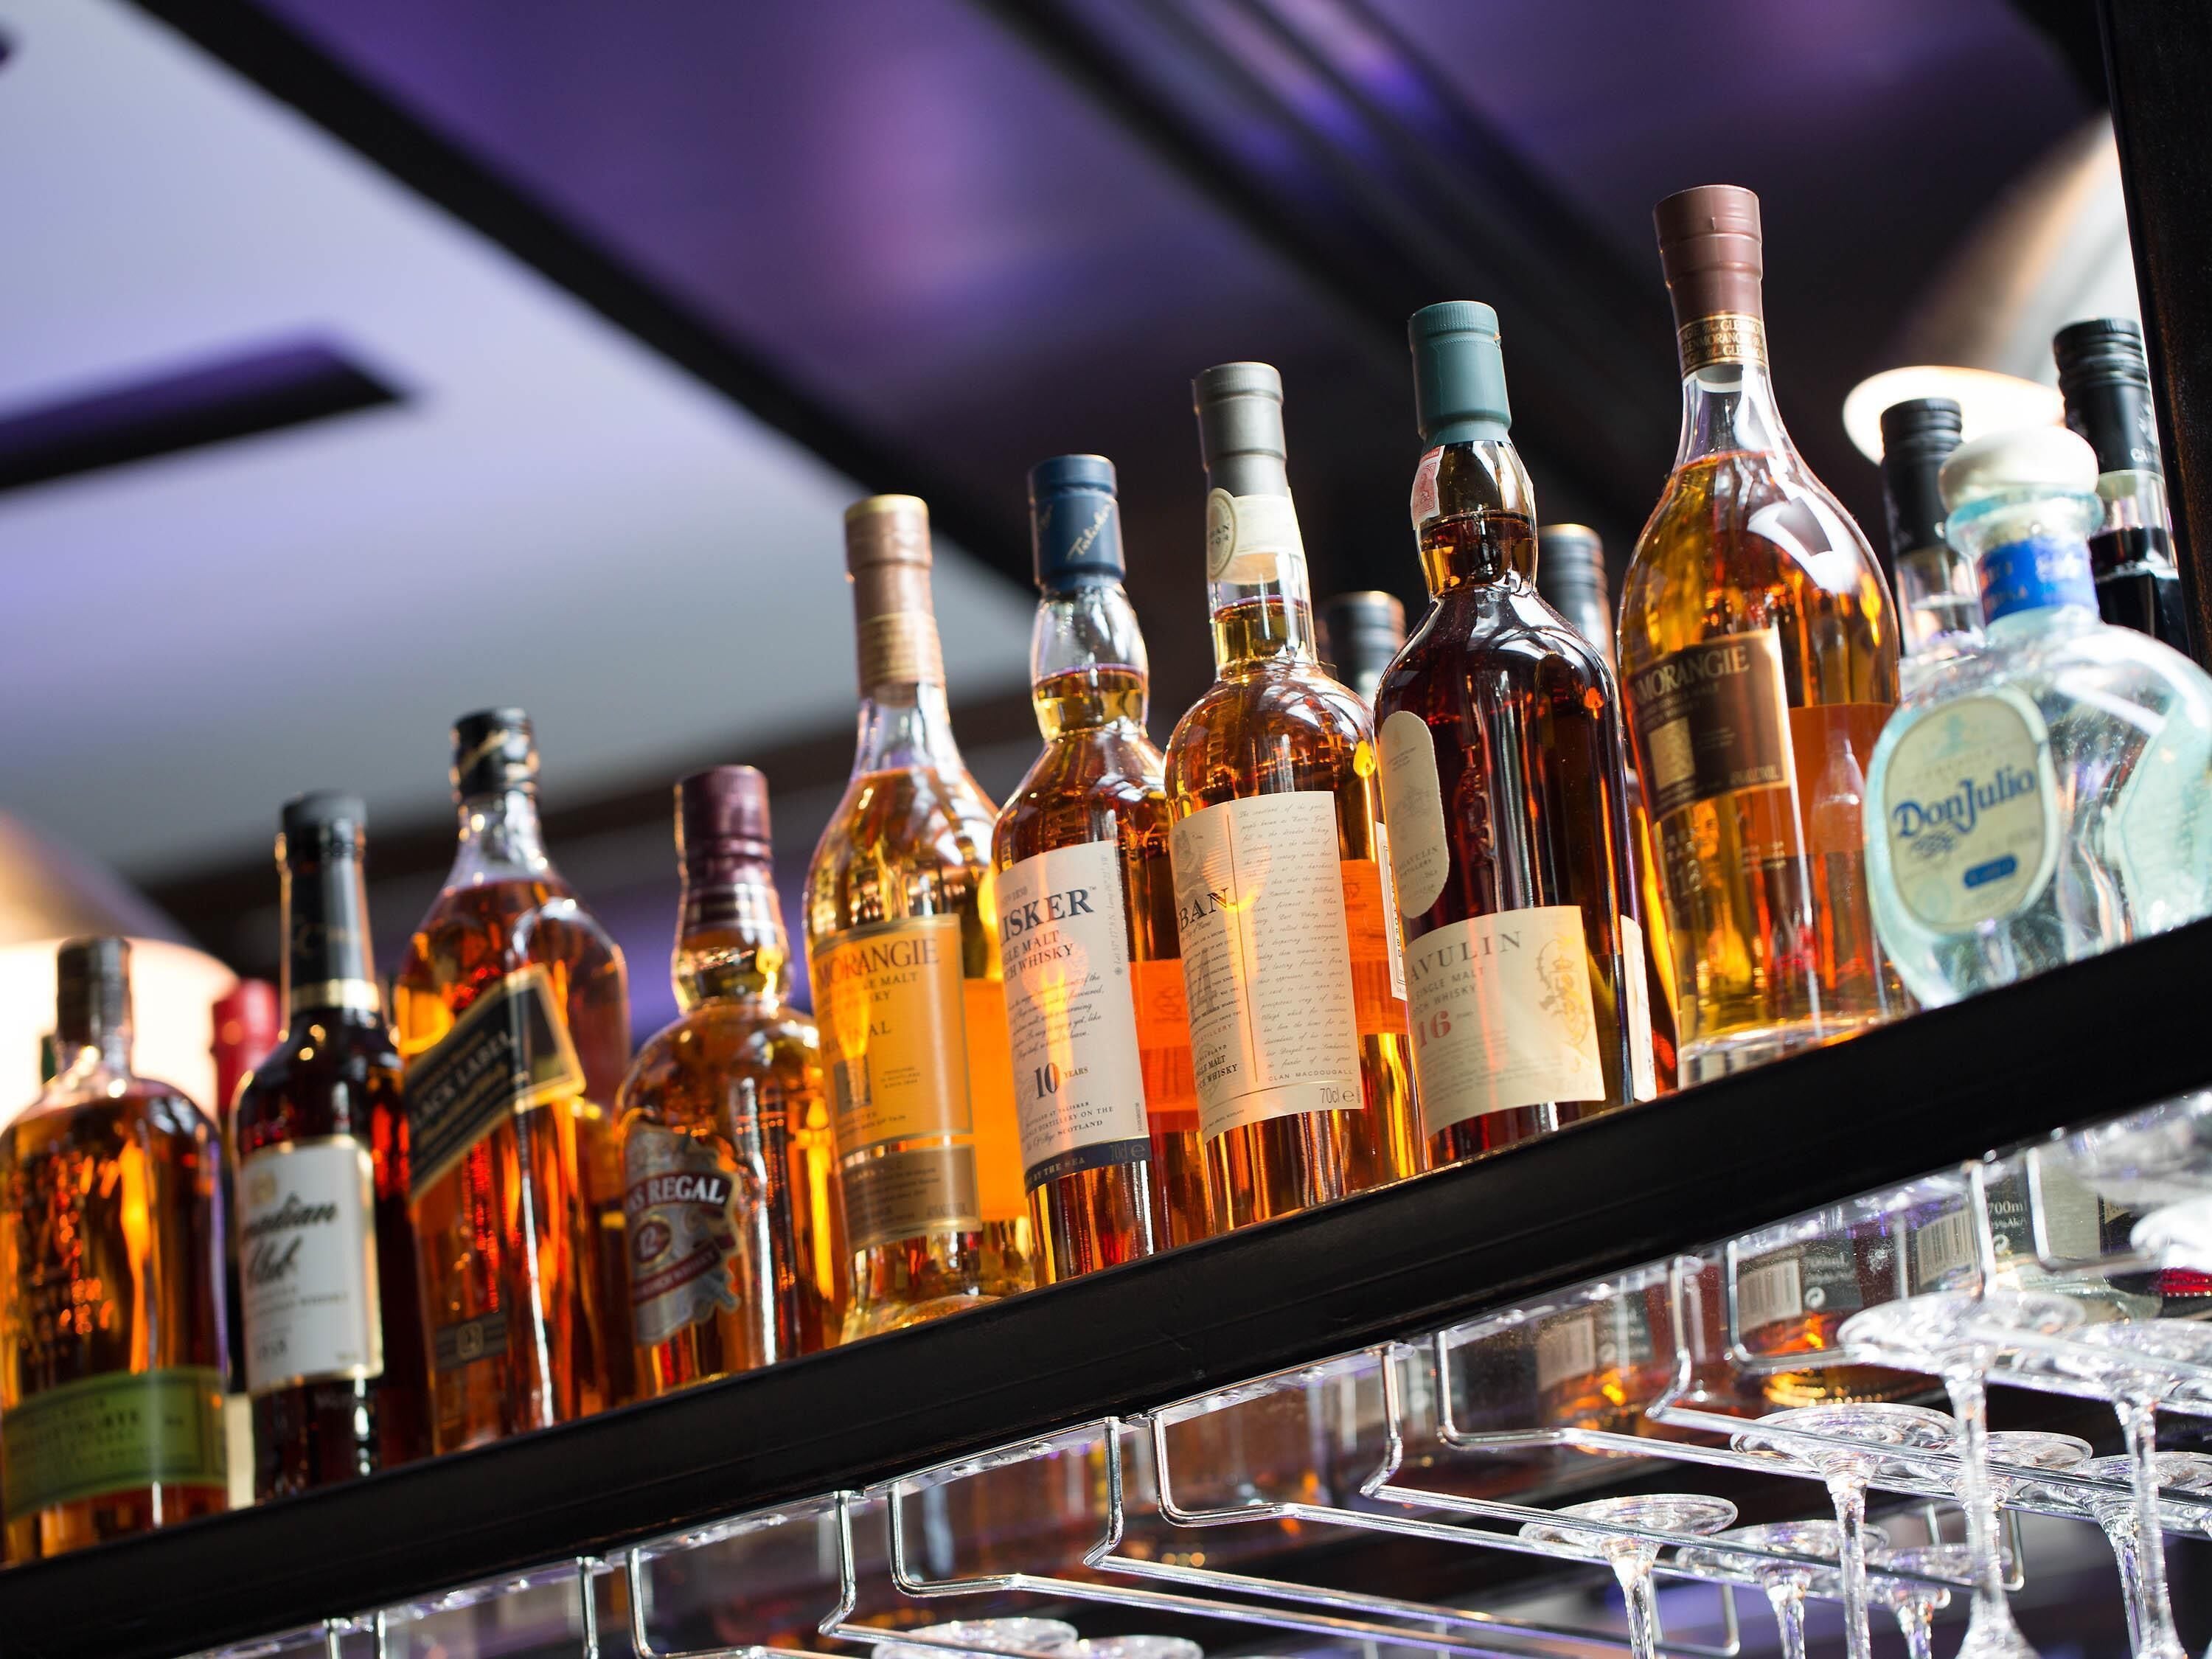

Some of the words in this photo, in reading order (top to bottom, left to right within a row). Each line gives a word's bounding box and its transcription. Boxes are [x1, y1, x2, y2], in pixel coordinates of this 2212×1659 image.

[1022, 930, 1060, 951] MALT
[1019, 943, 1074, 973] WHISKY
[880, 971, 919, 987] MALT
[1451, 967, 1484, 984] MALT
[1433, 984, 1477, 1006] WHISKY
[1417, 1009, 1452, 1048] 16
[1208, 1054, 1227, 1069] MALT
[1034, 1062, 1060, 1100] 10
[1062, 1066, 1090, 1079] YEARS
[1207, 1063, 1238, 1083] WHISKY
[1268, 1074, 1290, 1082] CLAN
[1295, 1069, 1354, 1077] MACDOUGALL
[1319, 1088, 1340, 1105] 70cl
[1081, 1109, 1093, 1118] ON
[1096, 1105, 1114, 1115] THE
[1057, 1119, 1104, 1135] SCOTLAND
[1044, 1163, 1062, 1176] THE
[647, 1175, 726, 1211] REGAL
